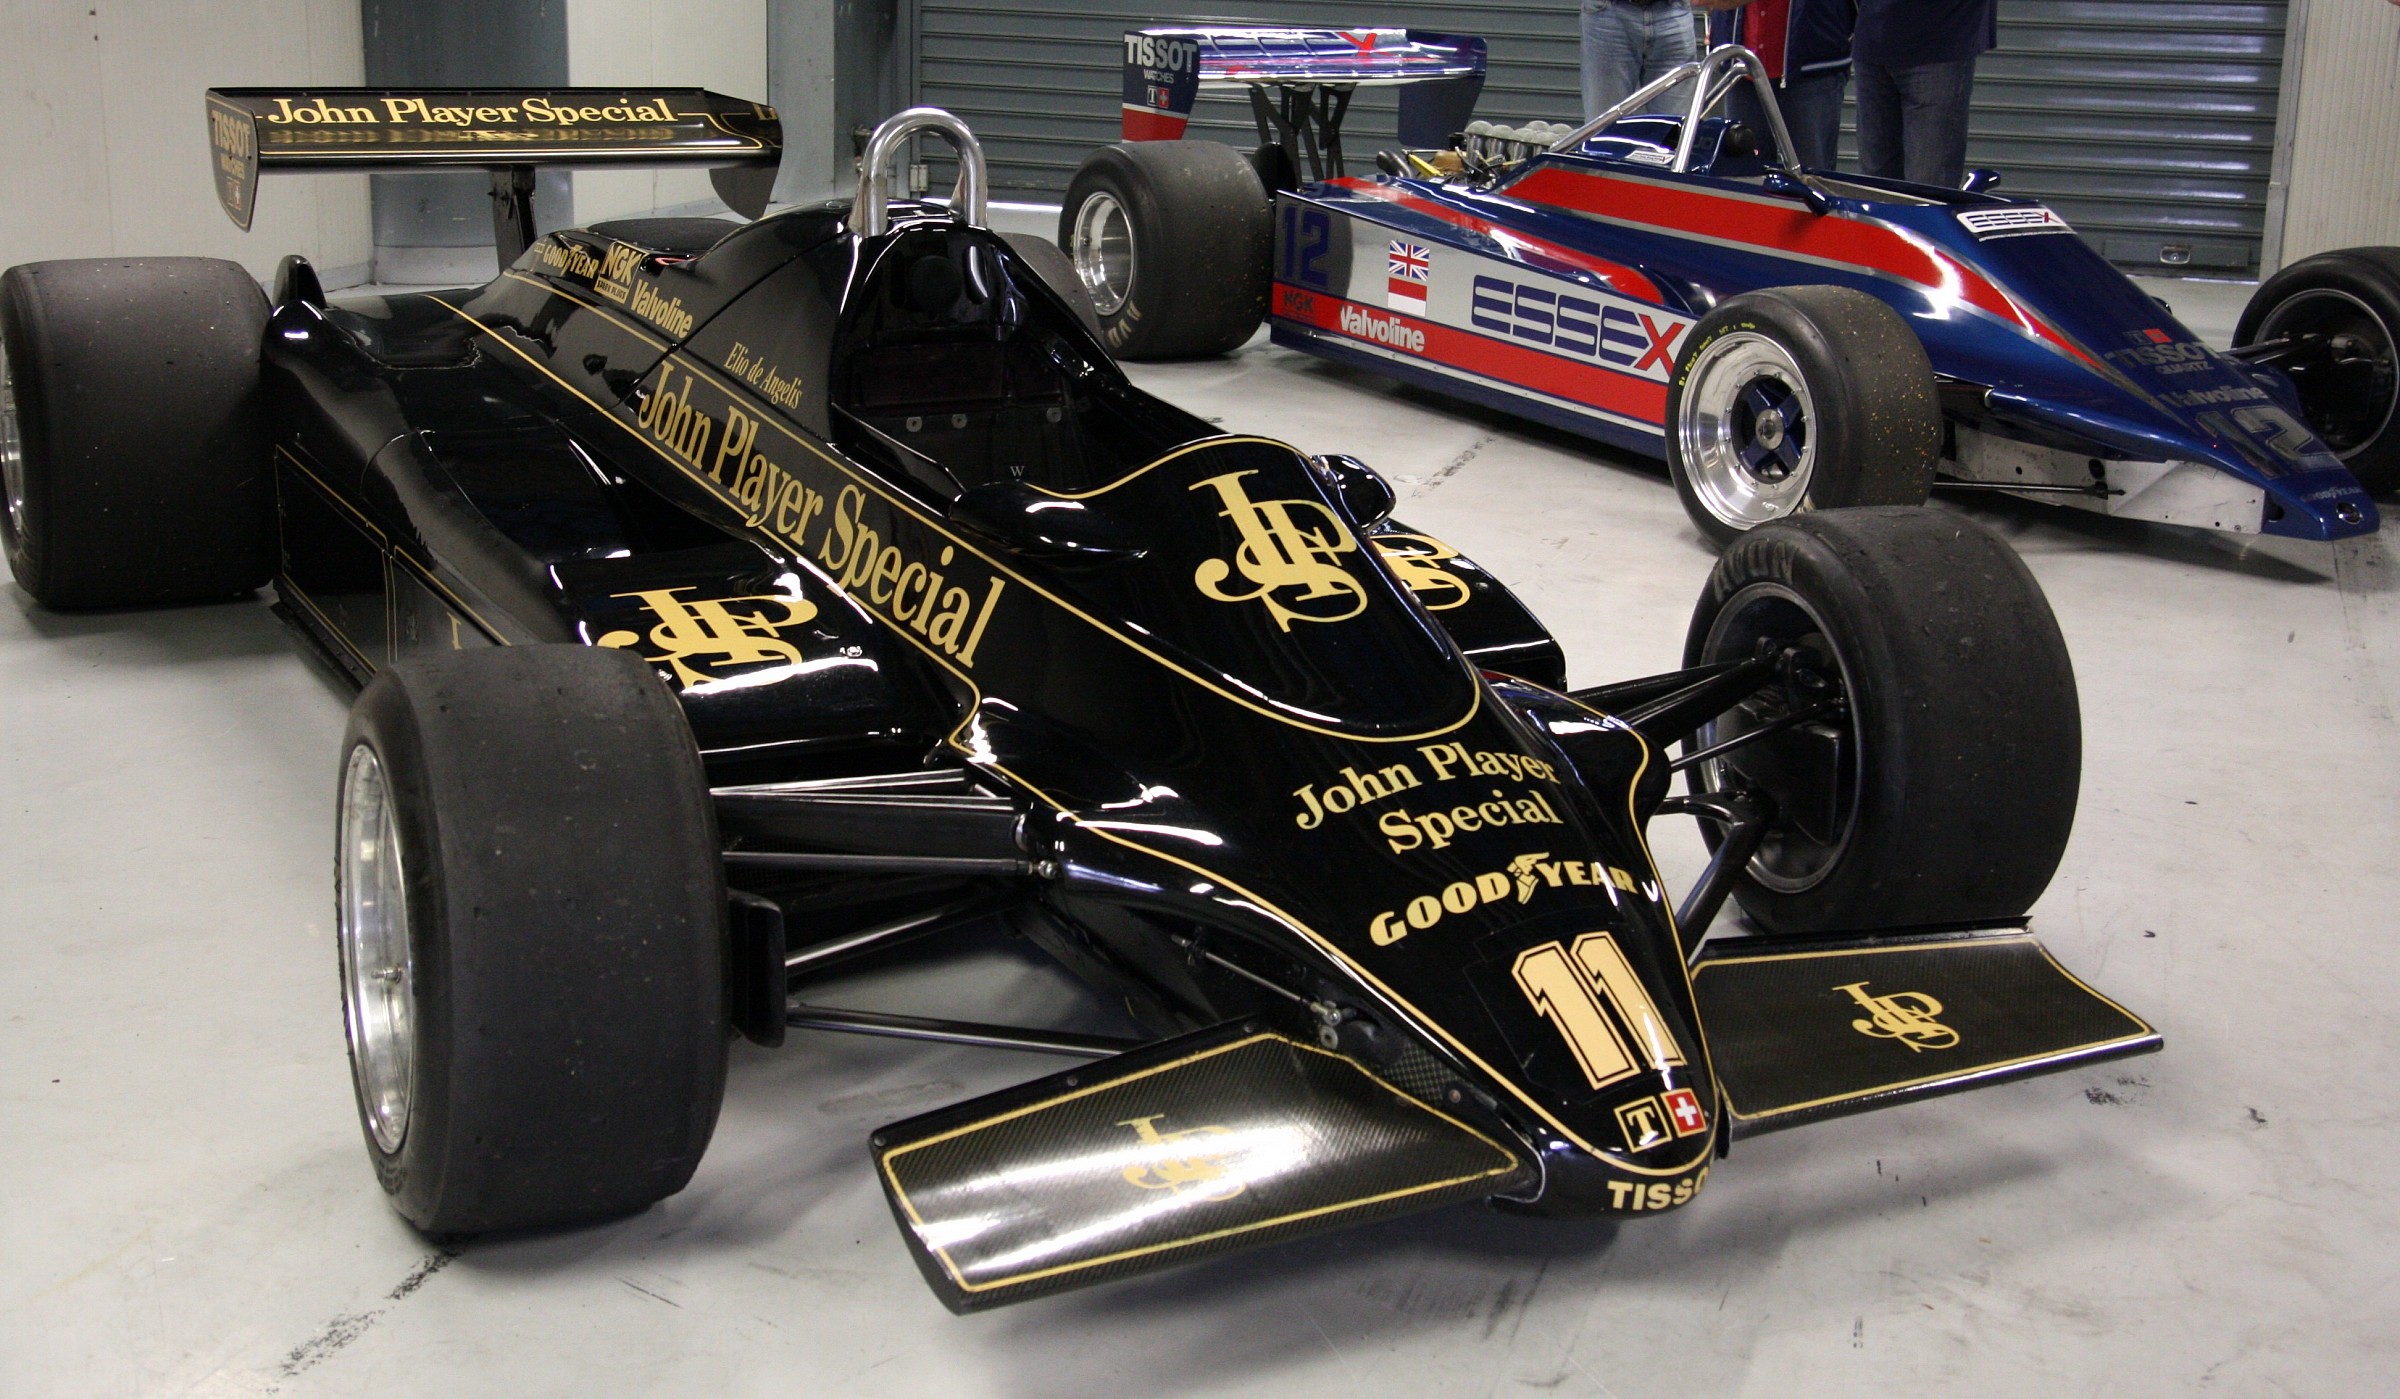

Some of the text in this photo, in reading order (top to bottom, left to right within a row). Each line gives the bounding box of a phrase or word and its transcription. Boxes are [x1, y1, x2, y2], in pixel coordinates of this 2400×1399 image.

[1124, 33, 1198, 74] TISSOT
[1143, 69, 1175, 84] WATCHES
[211, 109, 251, 158] TISSOT
[268, 98, 679, 127] John Player Special
[601, 244, 642, 287] NGK
[1283, 205, 1331, 288] 12
[631, 279, 694, 339] Valvoline
[1340, 304, 1425, 353] Valvoline
[1471, 274, 1686, 377] ESSEX
[723, 341, 803, 410] Elio de Angelis
[2104, 342, 2224, 369] TISSOT
[2155, 359, 2214, 375] QUARTZ
[2159, 384, 2269, 407] Valvoline
[2195, 405, 2348, 480] 12
[638, 360, 1006, 670] John Player Special
[1293, 741, 1562, 831] John Player
[1378, 789, 1564, 855] Special
[1511, 931, 1688, 1091] 11
[1626, 1107, 1659, 1146] T
